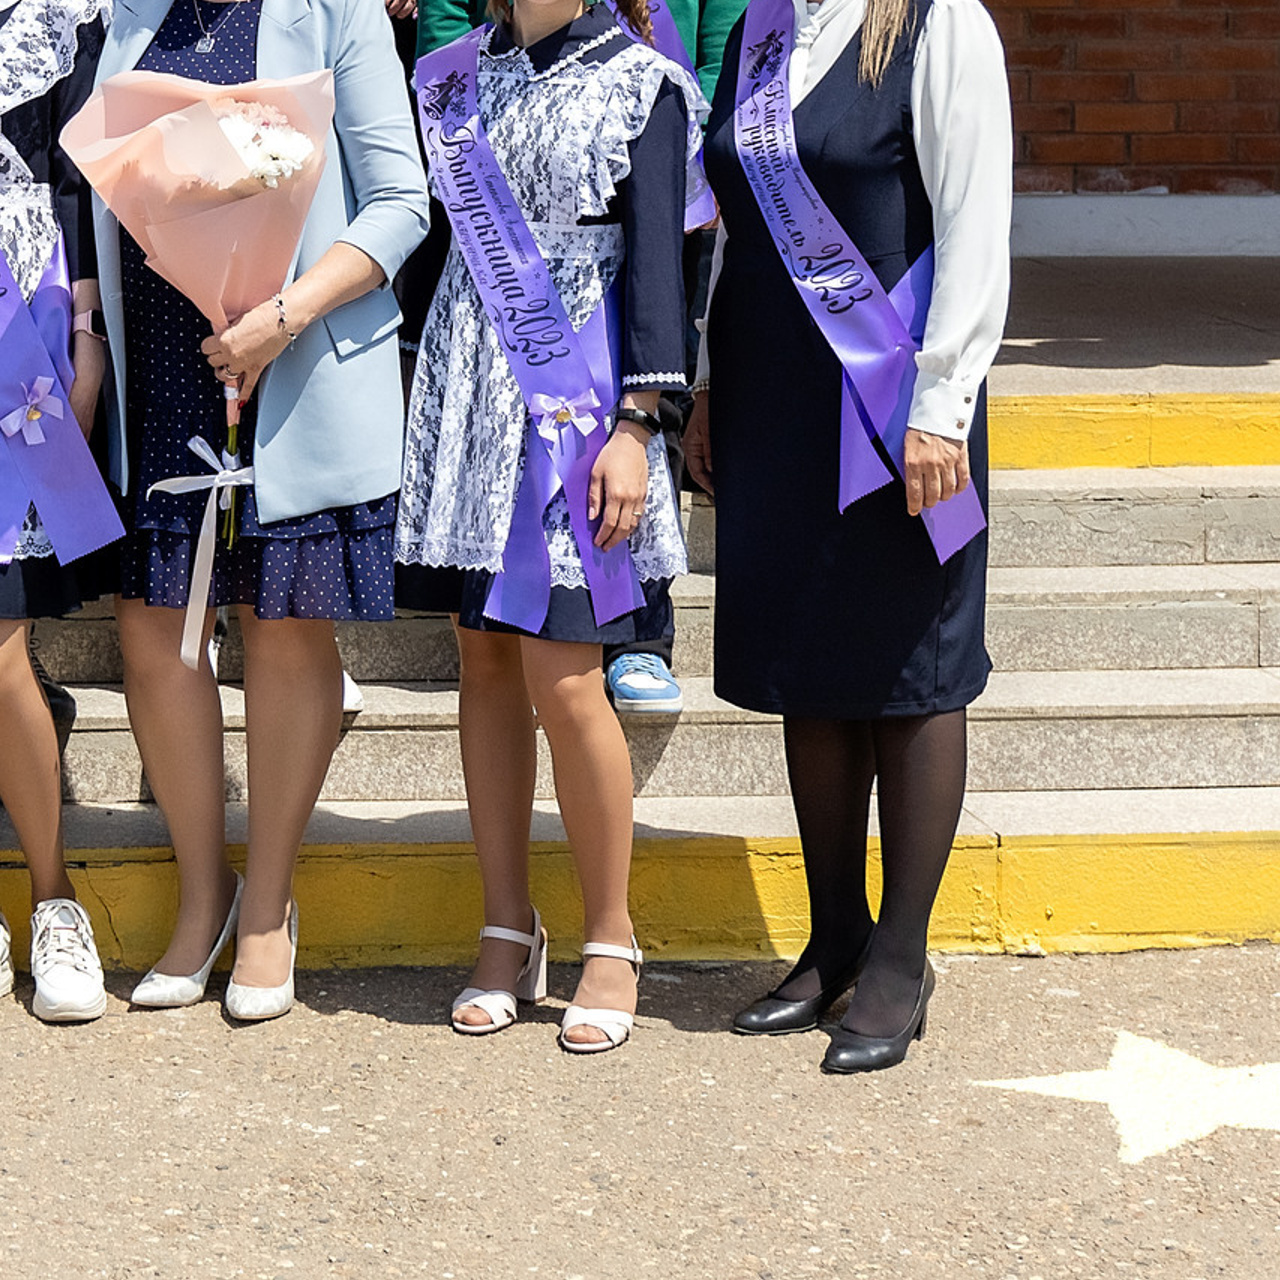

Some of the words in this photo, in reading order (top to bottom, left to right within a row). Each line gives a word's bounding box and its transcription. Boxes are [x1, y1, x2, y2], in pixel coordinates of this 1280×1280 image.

[763, 78, 787, 175] Классный
[741, 123, 806, 248] руководитель
[438, 121, 526, 303] Выпускница
[504, 298, 571, 367] 2023
[799, 243, 873, 315] 2023
